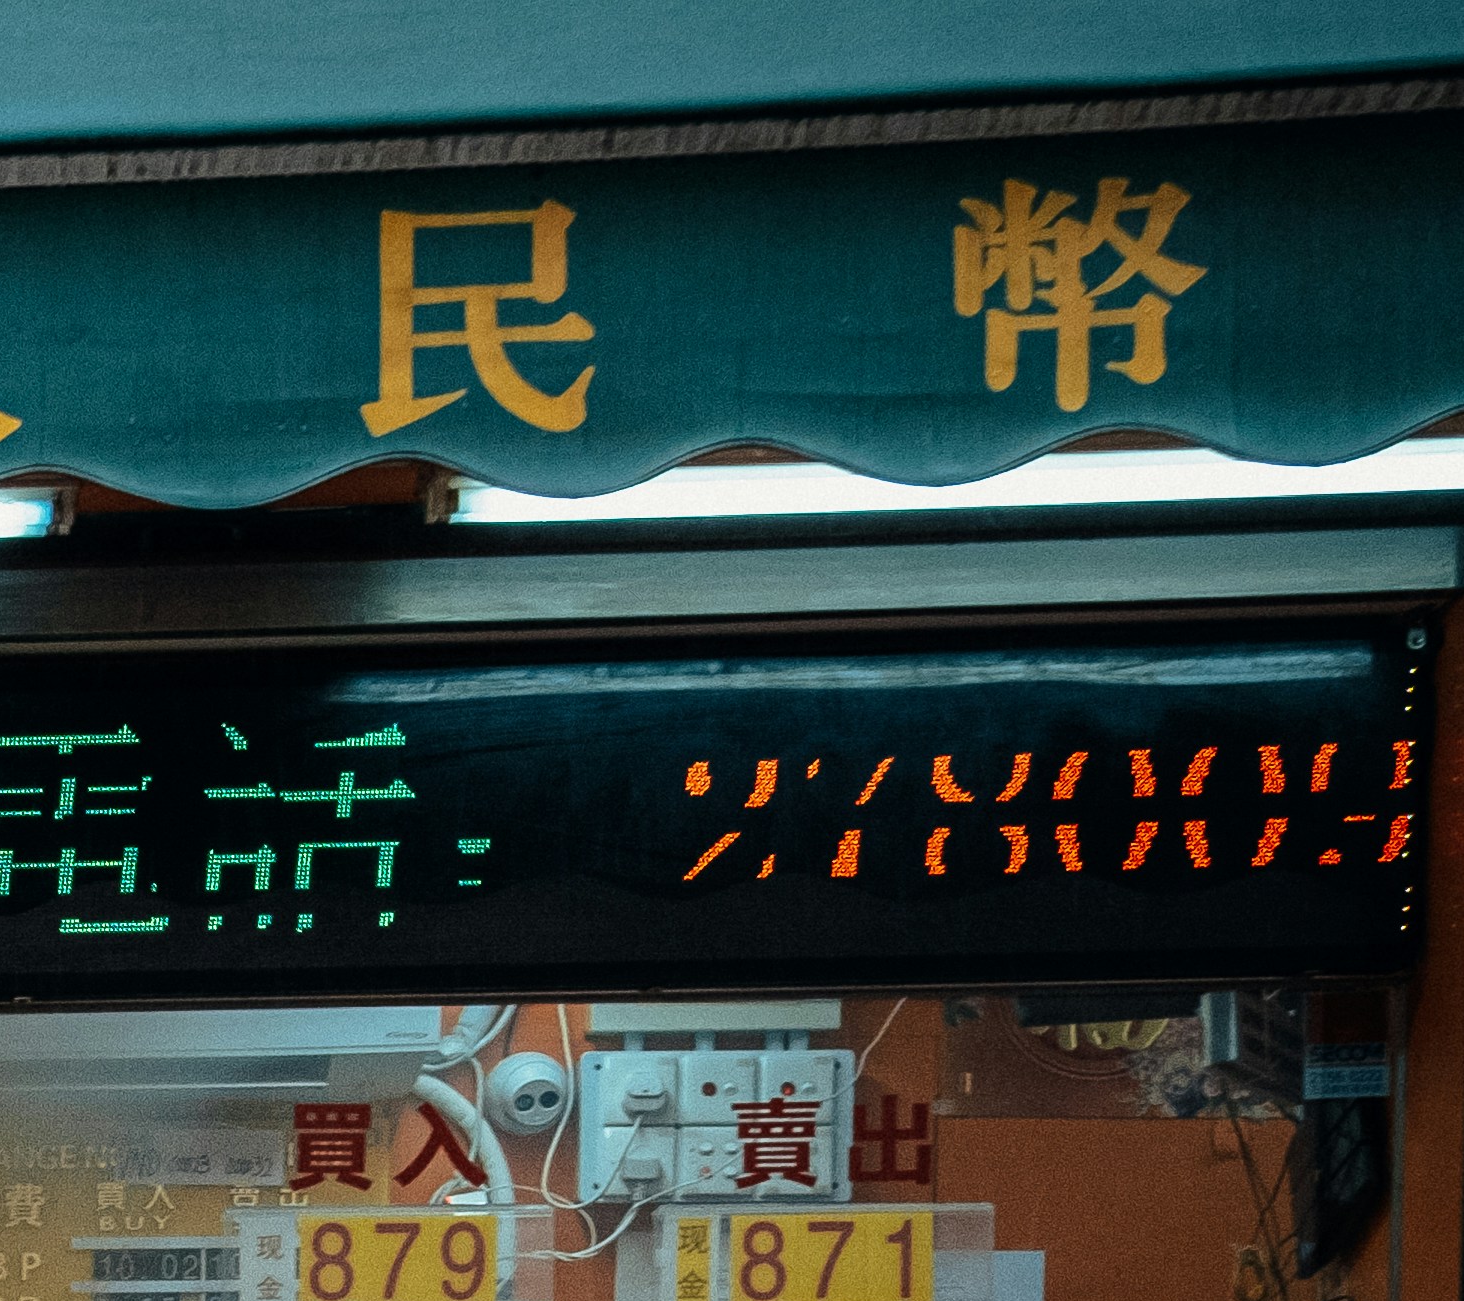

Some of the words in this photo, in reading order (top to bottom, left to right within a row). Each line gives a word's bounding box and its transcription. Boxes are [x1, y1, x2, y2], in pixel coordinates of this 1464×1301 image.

[289, 1102, 488, 1190] 買入
[731, 1095, 932, 1190] 賣出
[310, 1221, 487, 1301] 879
[740, 1220, 916, 1301] 871
